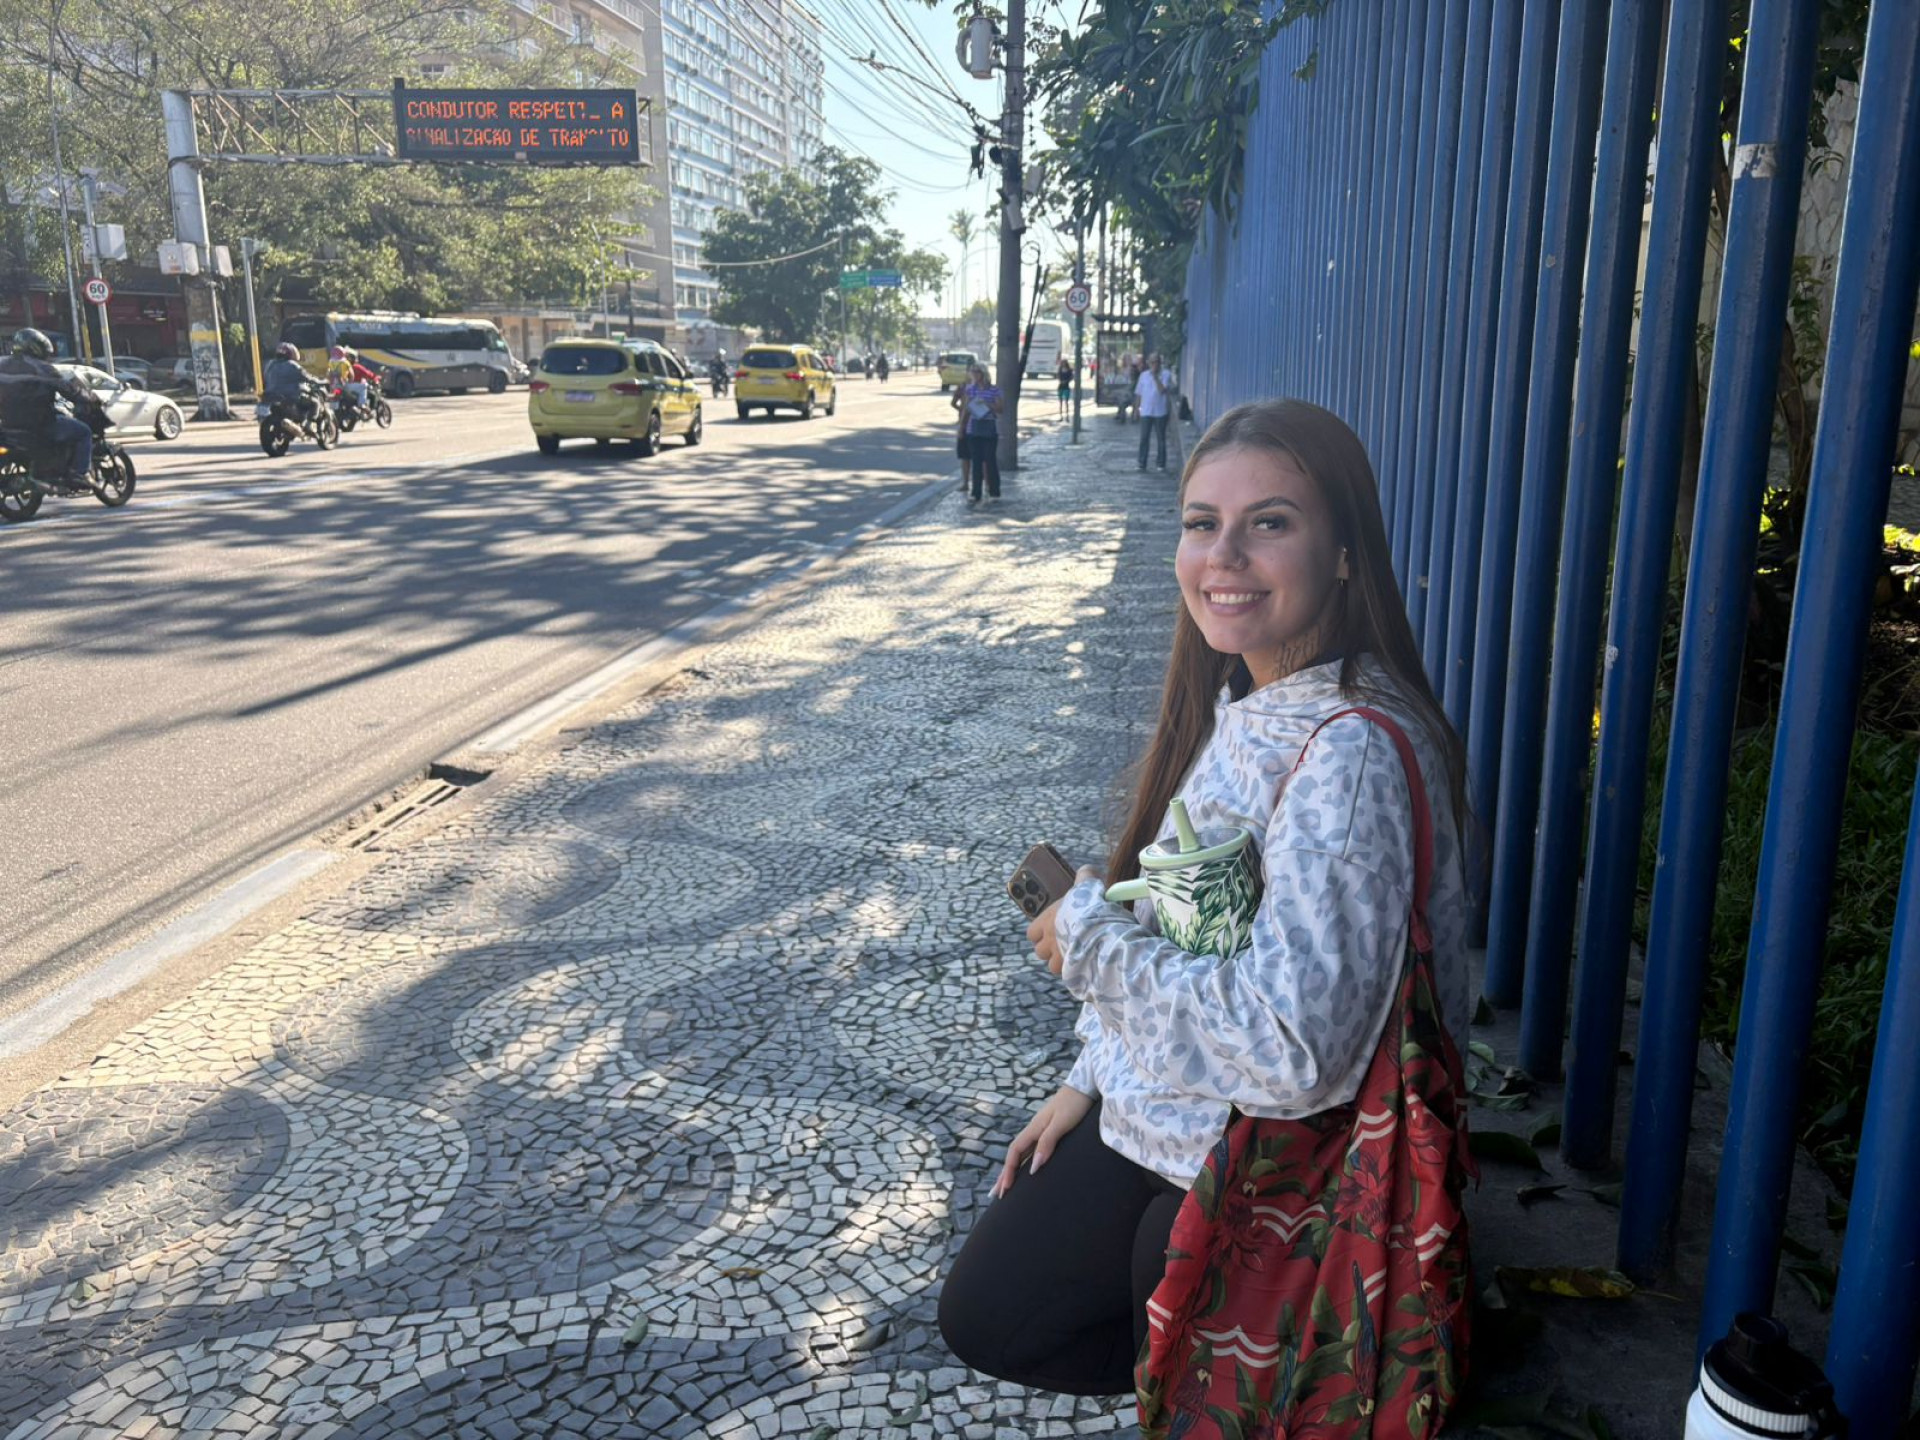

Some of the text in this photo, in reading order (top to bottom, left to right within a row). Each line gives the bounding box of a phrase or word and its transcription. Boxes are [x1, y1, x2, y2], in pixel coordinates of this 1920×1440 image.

[407, 101, 499, 119] CONDUTOR
[612, 101, 624, 119] A
[520, 128, 540, 146] DE
[90, 283, 105, 294] 60
[1070, 292, 1086, 303] 60
